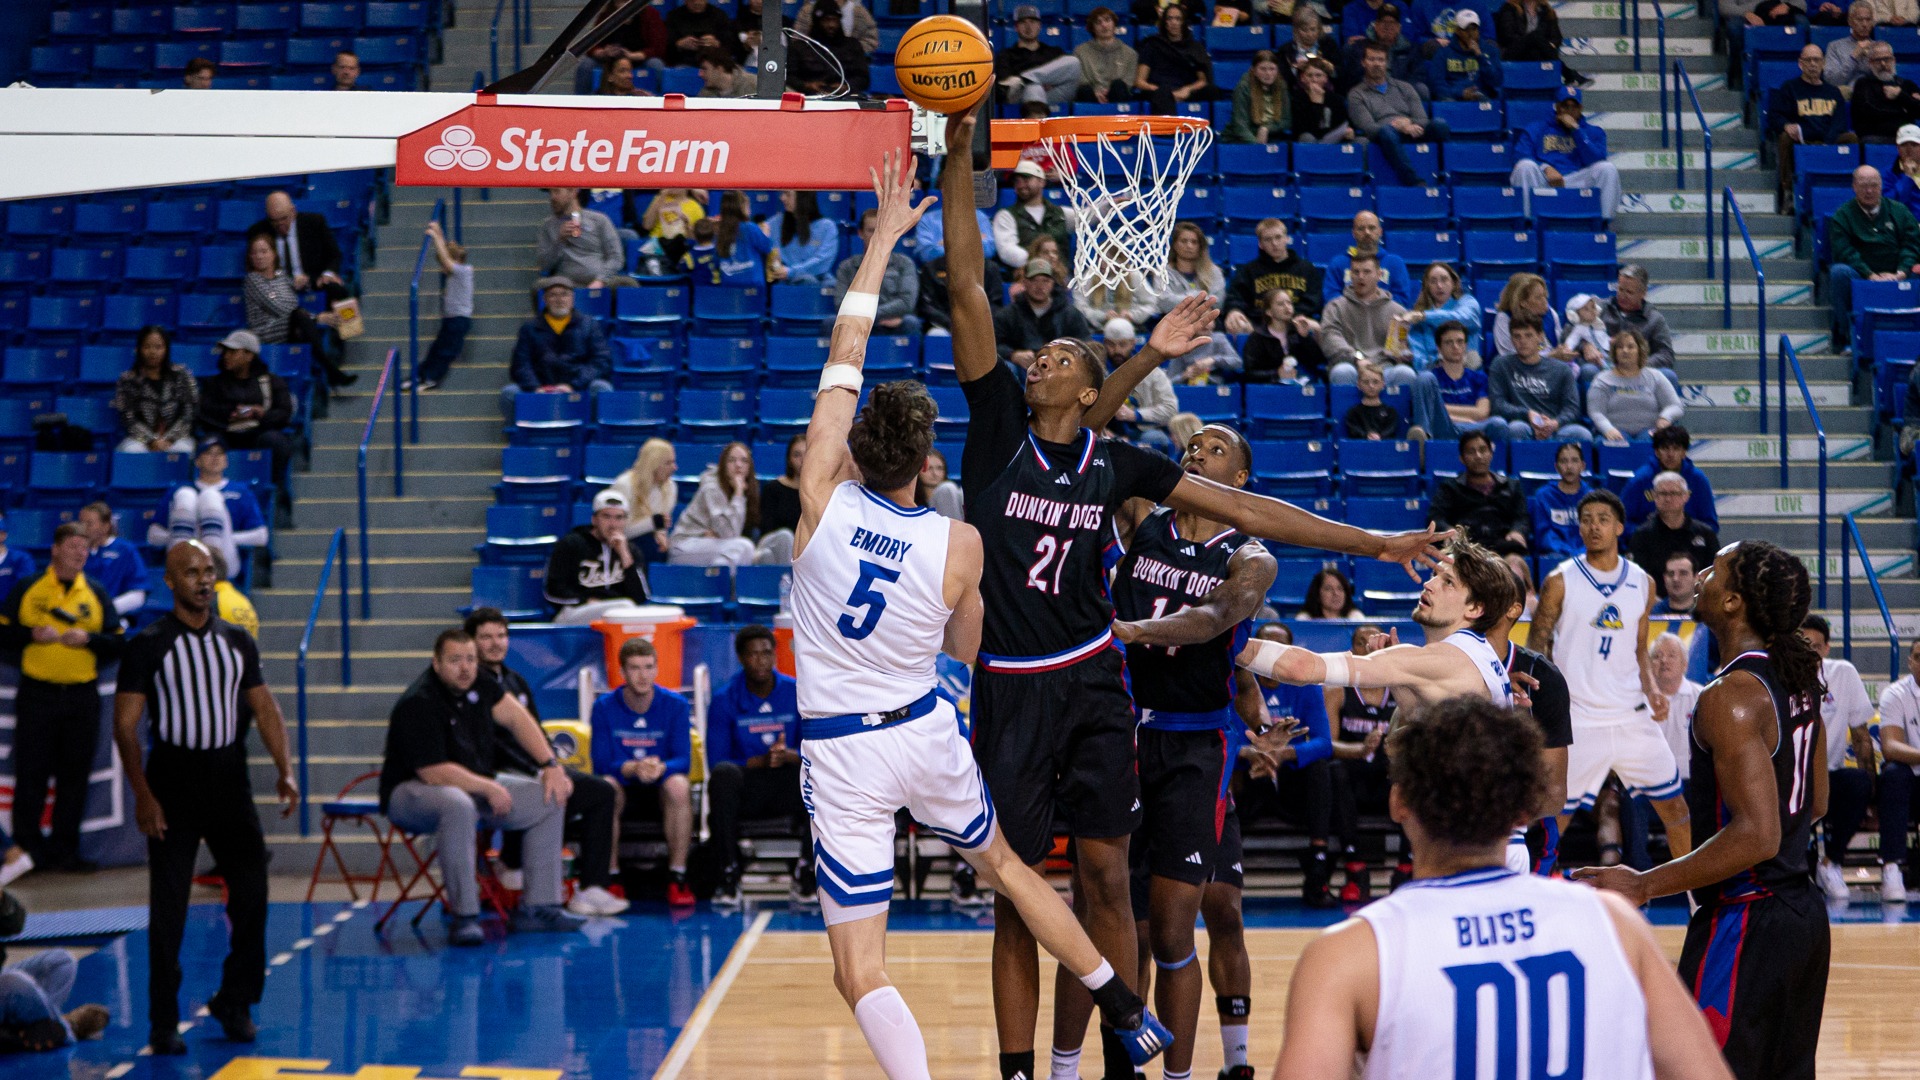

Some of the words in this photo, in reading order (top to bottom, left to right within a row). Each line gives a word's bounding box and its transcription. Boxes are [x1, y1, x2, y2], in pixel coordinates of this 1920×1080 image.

[911, 70, 977, 92] Wilson
[1005, 492, 1067, 527] DUNKIN'
[1068, 504, 1104, 531] DOGS
[1774, 496, 1803, 513] LOVE
[849, 526, 912, 563] EMORY
[1026, 533, 1073, 595] 21
[837, 559, 901, 641] 5
[1598, 635, 1613, 661] 4
[1788, 719, 1815, 817] 11
[1454, 908, 1536, 948] BLISS
[1440, 950, 1586, 1080] 00
